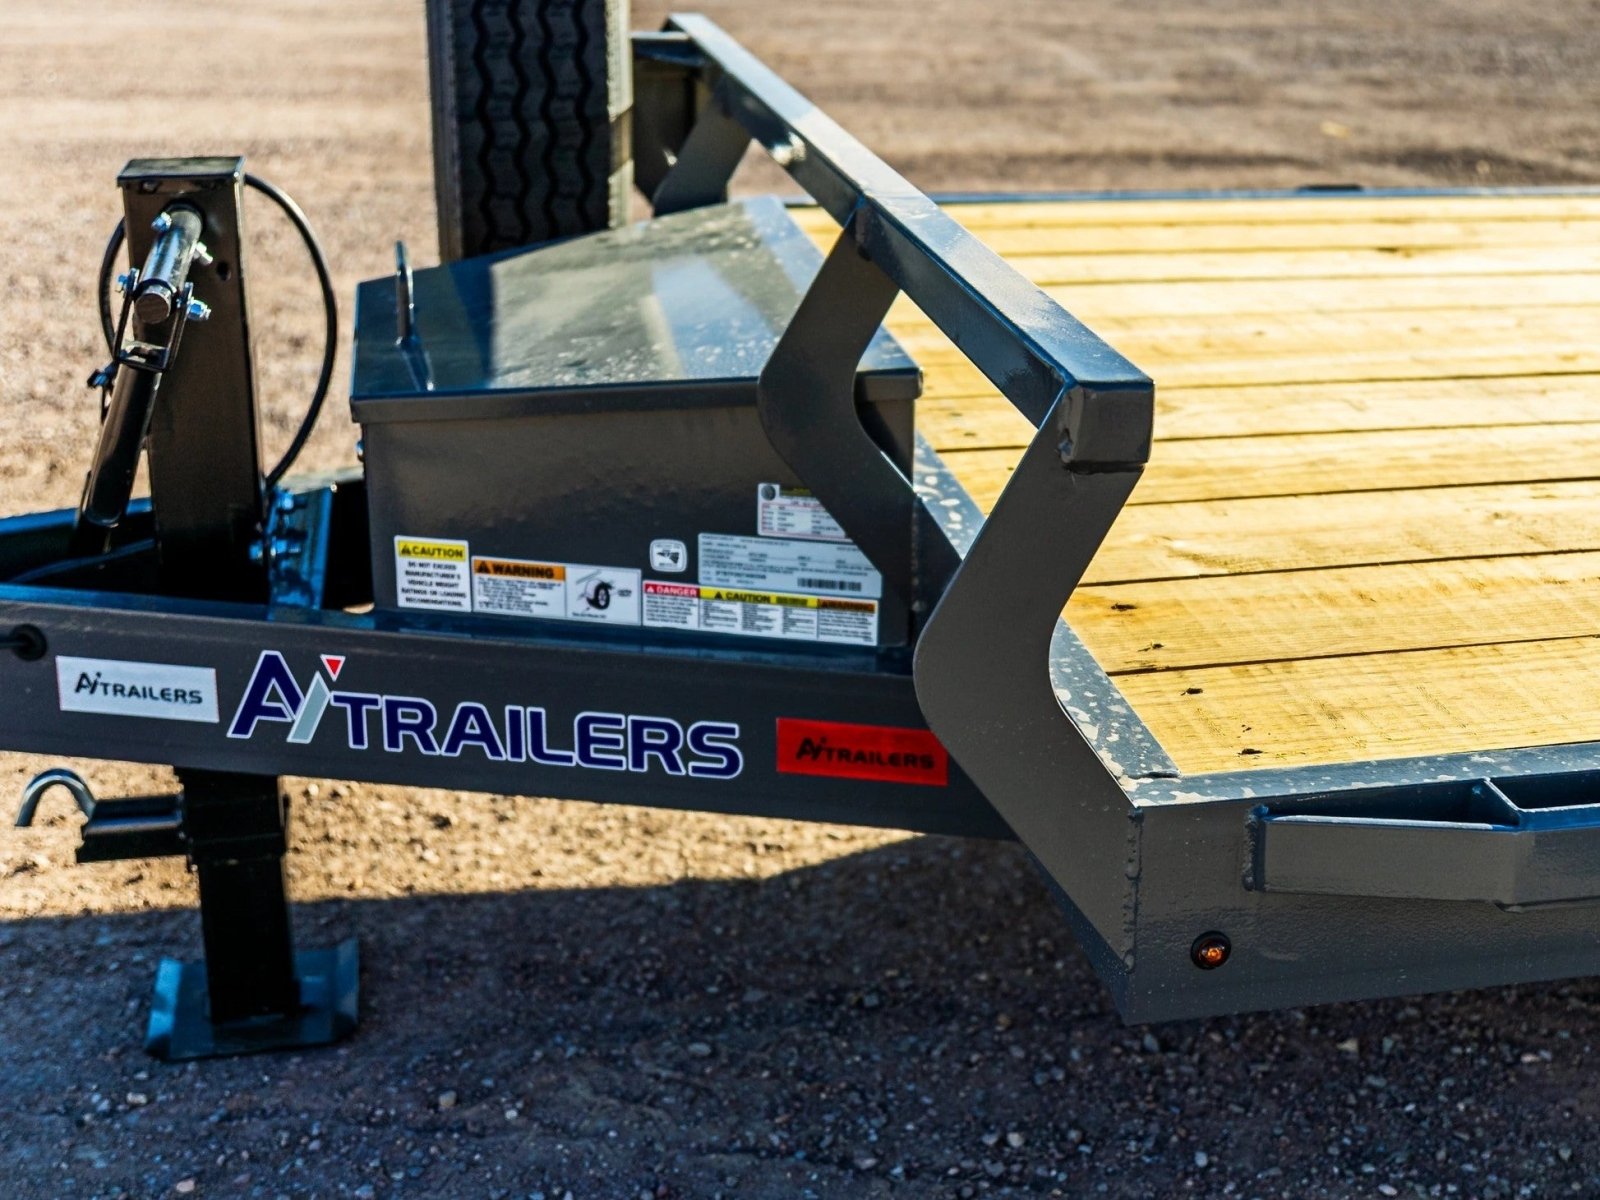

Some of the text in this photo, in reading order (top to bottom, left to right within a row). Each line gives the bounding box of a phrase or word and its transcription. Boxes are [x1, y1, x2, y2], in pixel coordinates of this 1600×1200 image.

[412, 545, 463, 558] CAUTION
[493, 562, 554, 579] WARNING
[656, 585, 697, 597] DANGER
[725, 592, 770, 604] CAUTION
